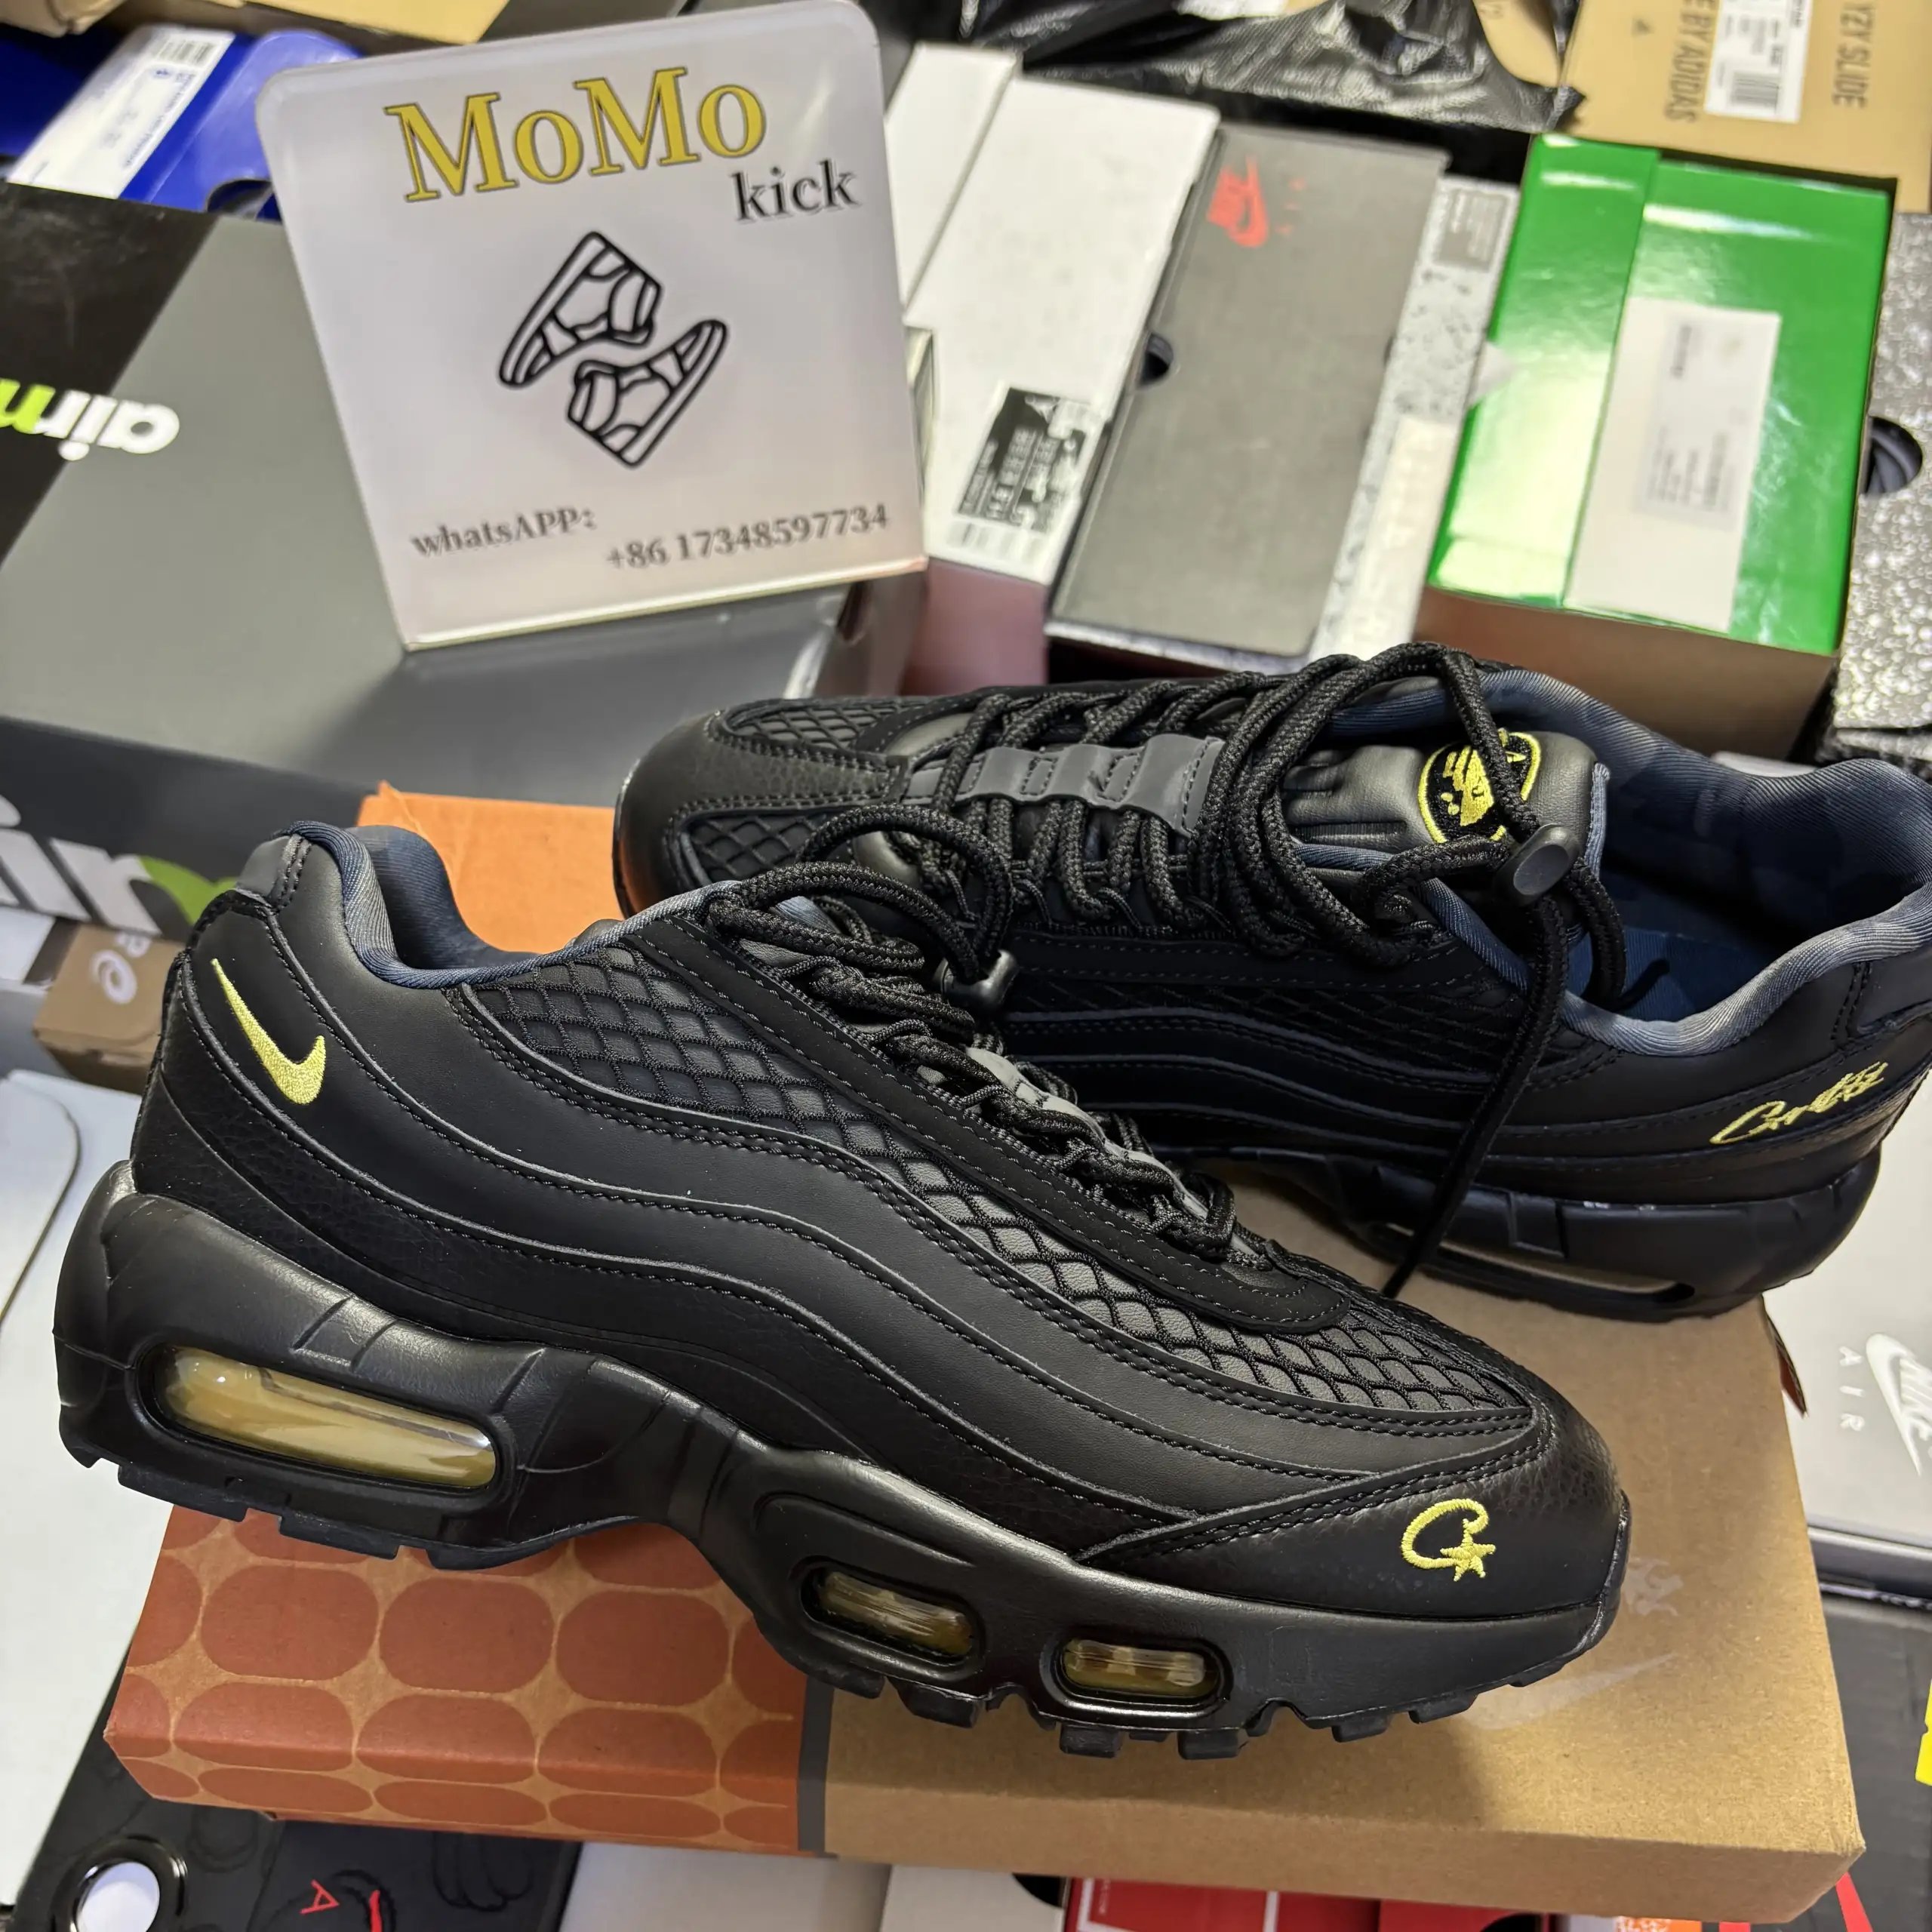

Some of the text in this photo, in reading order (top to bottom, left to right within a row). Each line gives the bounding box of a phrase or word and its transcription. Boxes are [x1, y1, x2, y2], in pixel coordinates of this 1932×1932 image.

[383, 66, 768, 204] MoMo
[730, 158, 862, 224] kick
[606, 503, 890, 570] +86 17348597734
